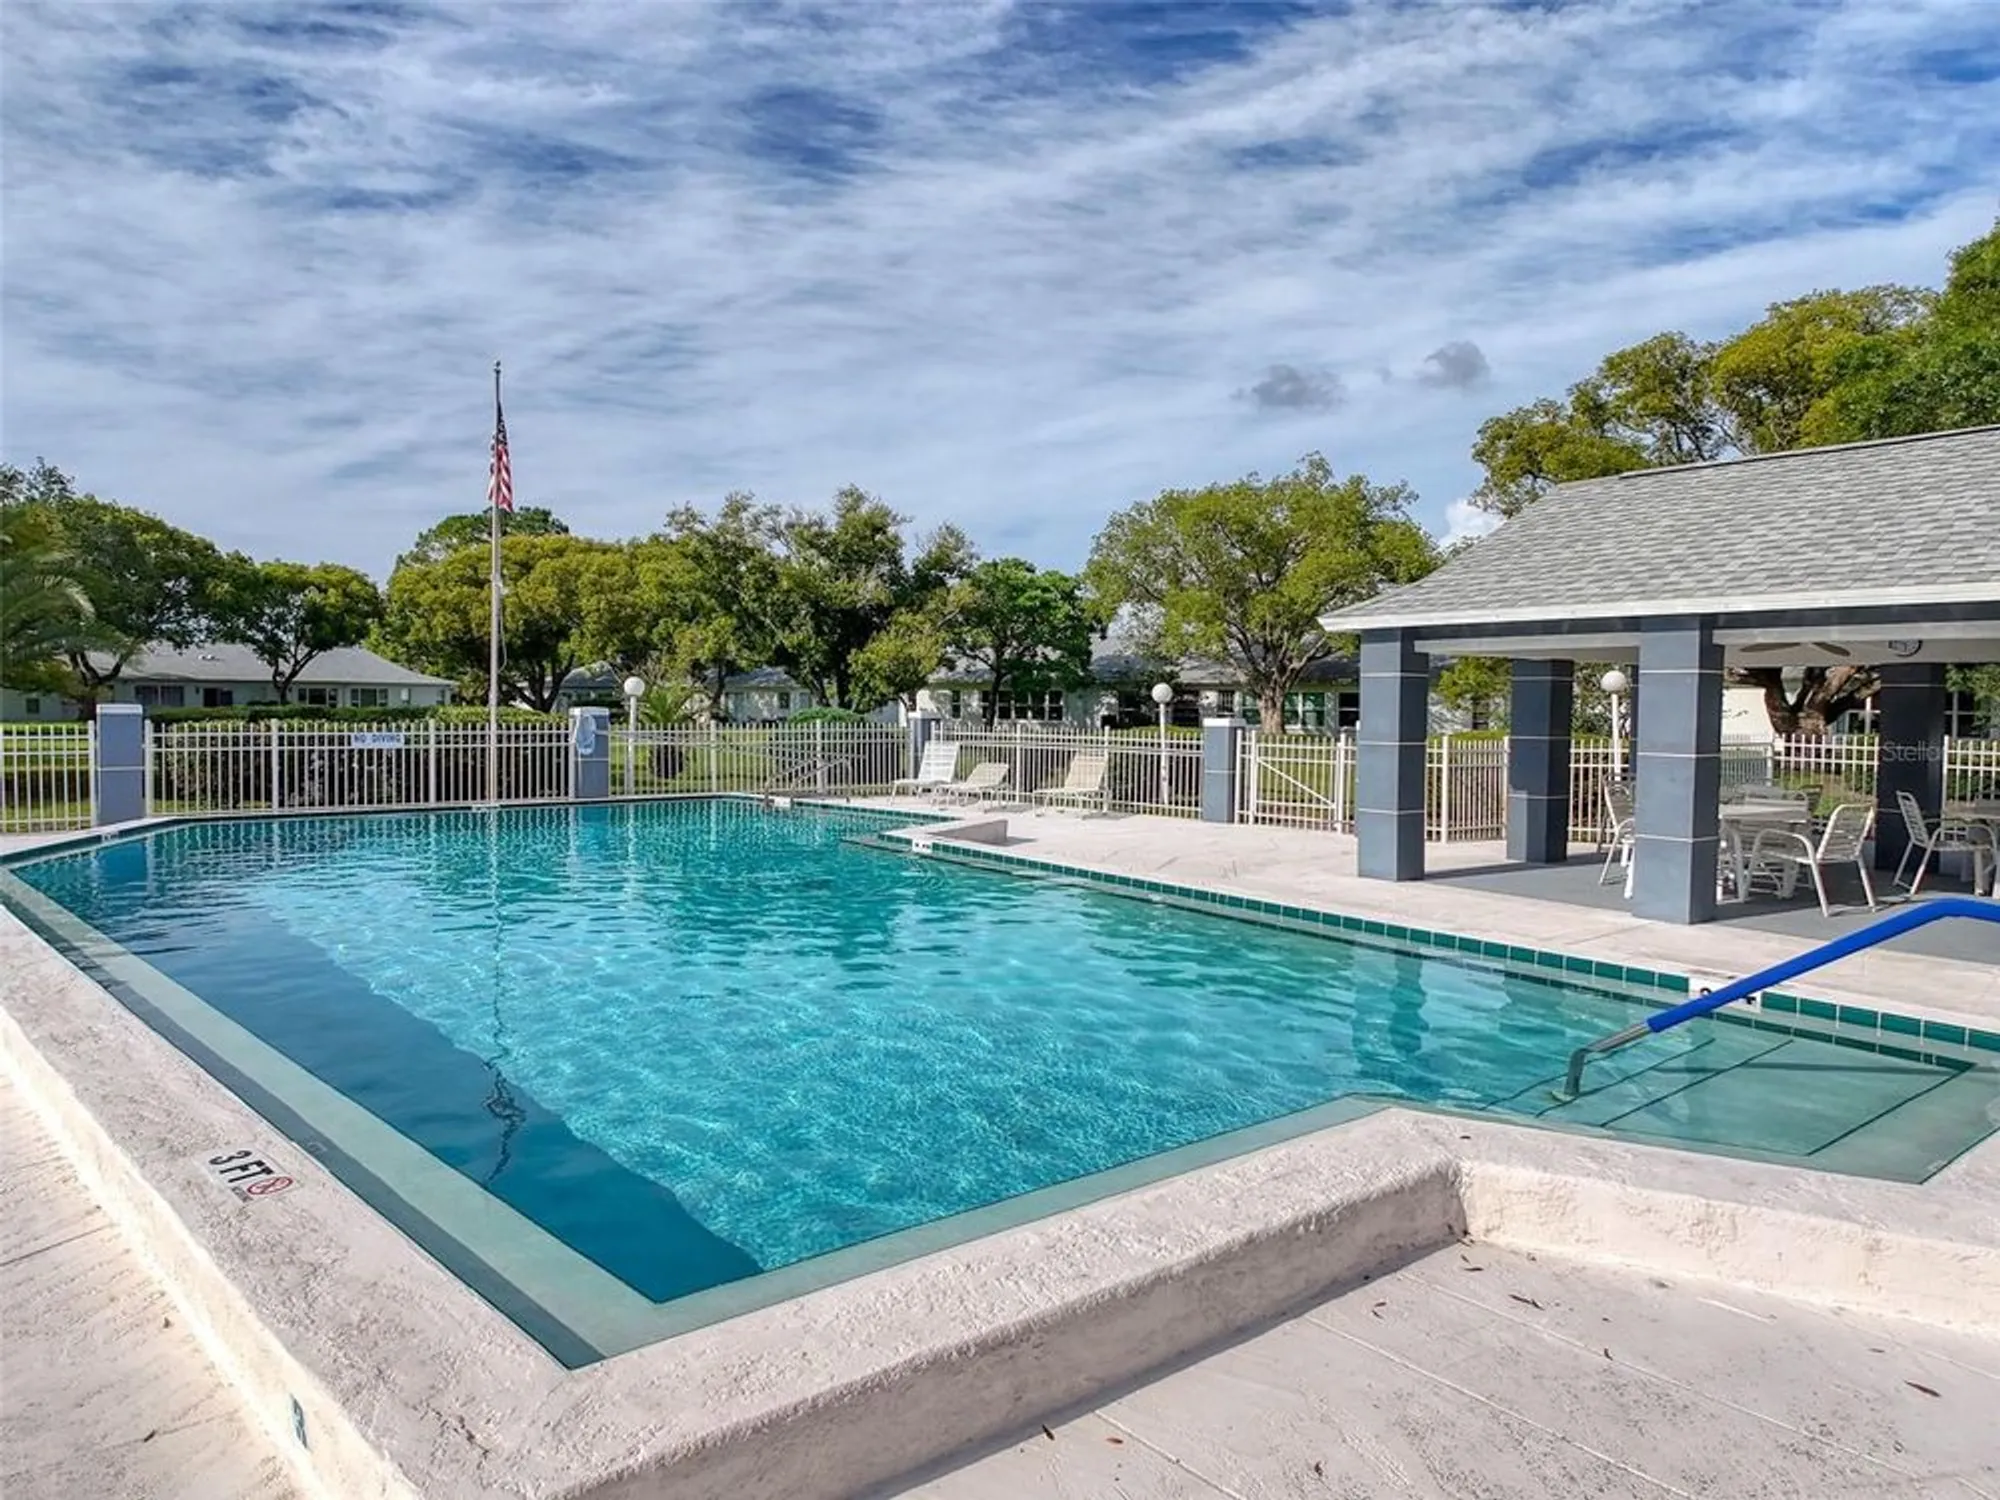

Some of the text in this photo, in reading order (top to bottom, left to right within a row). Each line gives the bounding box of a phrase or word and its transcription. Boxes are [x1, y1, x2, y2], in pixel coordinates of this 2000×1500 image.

[354, 734, 367, 743] NO
[208, 1150, 275, 1184] 3 FT
